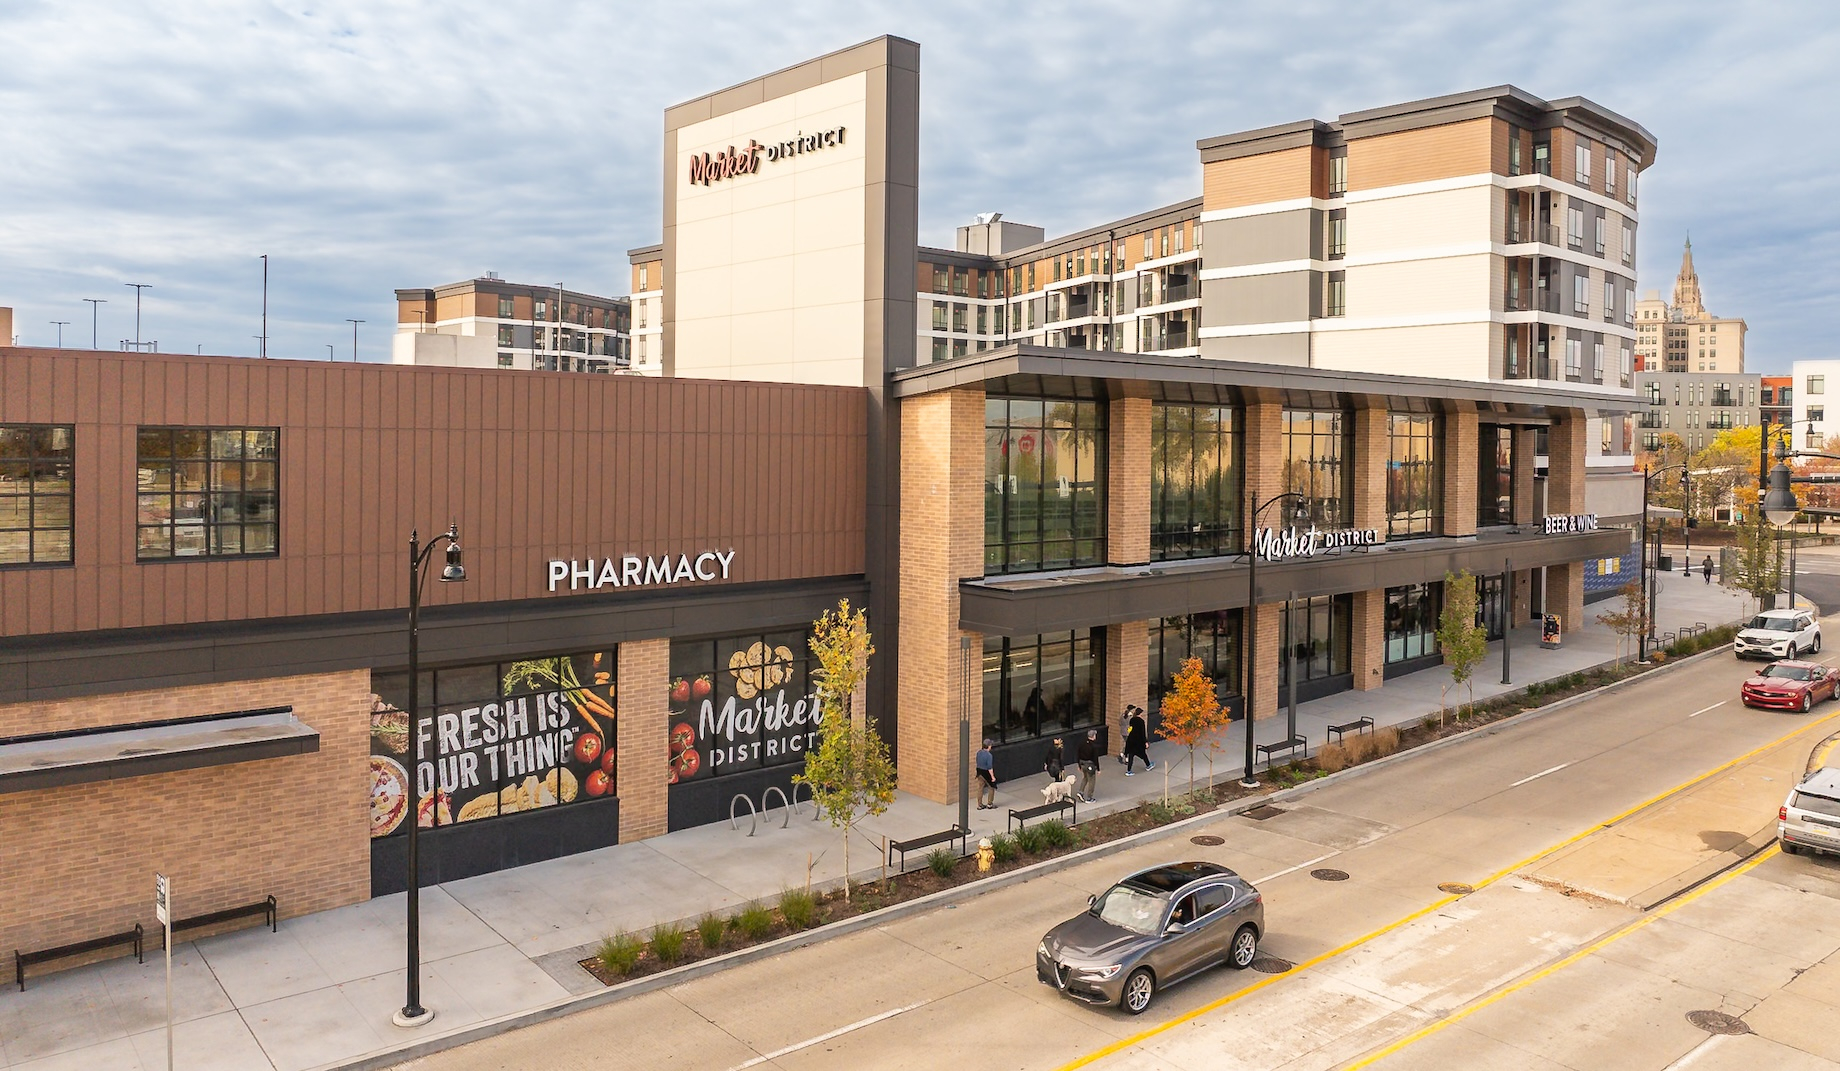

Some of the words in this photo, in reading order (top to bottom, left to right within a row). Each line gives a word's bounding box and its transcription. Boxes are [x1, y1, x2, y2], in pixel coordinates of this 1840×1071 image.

[689, 139, 764, 186] Market
[766, 126, 845, 162] DISTRICT
[1255, 525, 1322, 561] Market
[1326, 530, 1378, 547] DISTRICT
[1545, 516, 1568, 534] BEER
[1569, 516, 1577, 532] &
[1577, 514, 1598, 532] WINE
[549, 551, 736, 592] PHARMACY
[417, 697, 529, 760] FRESH
[536, 691, 571, 732] IS
[699, 686, 825, 742] Market
[709, 732, 816, 767] DISTRICT
[417, 752, 480, 799] OUR
